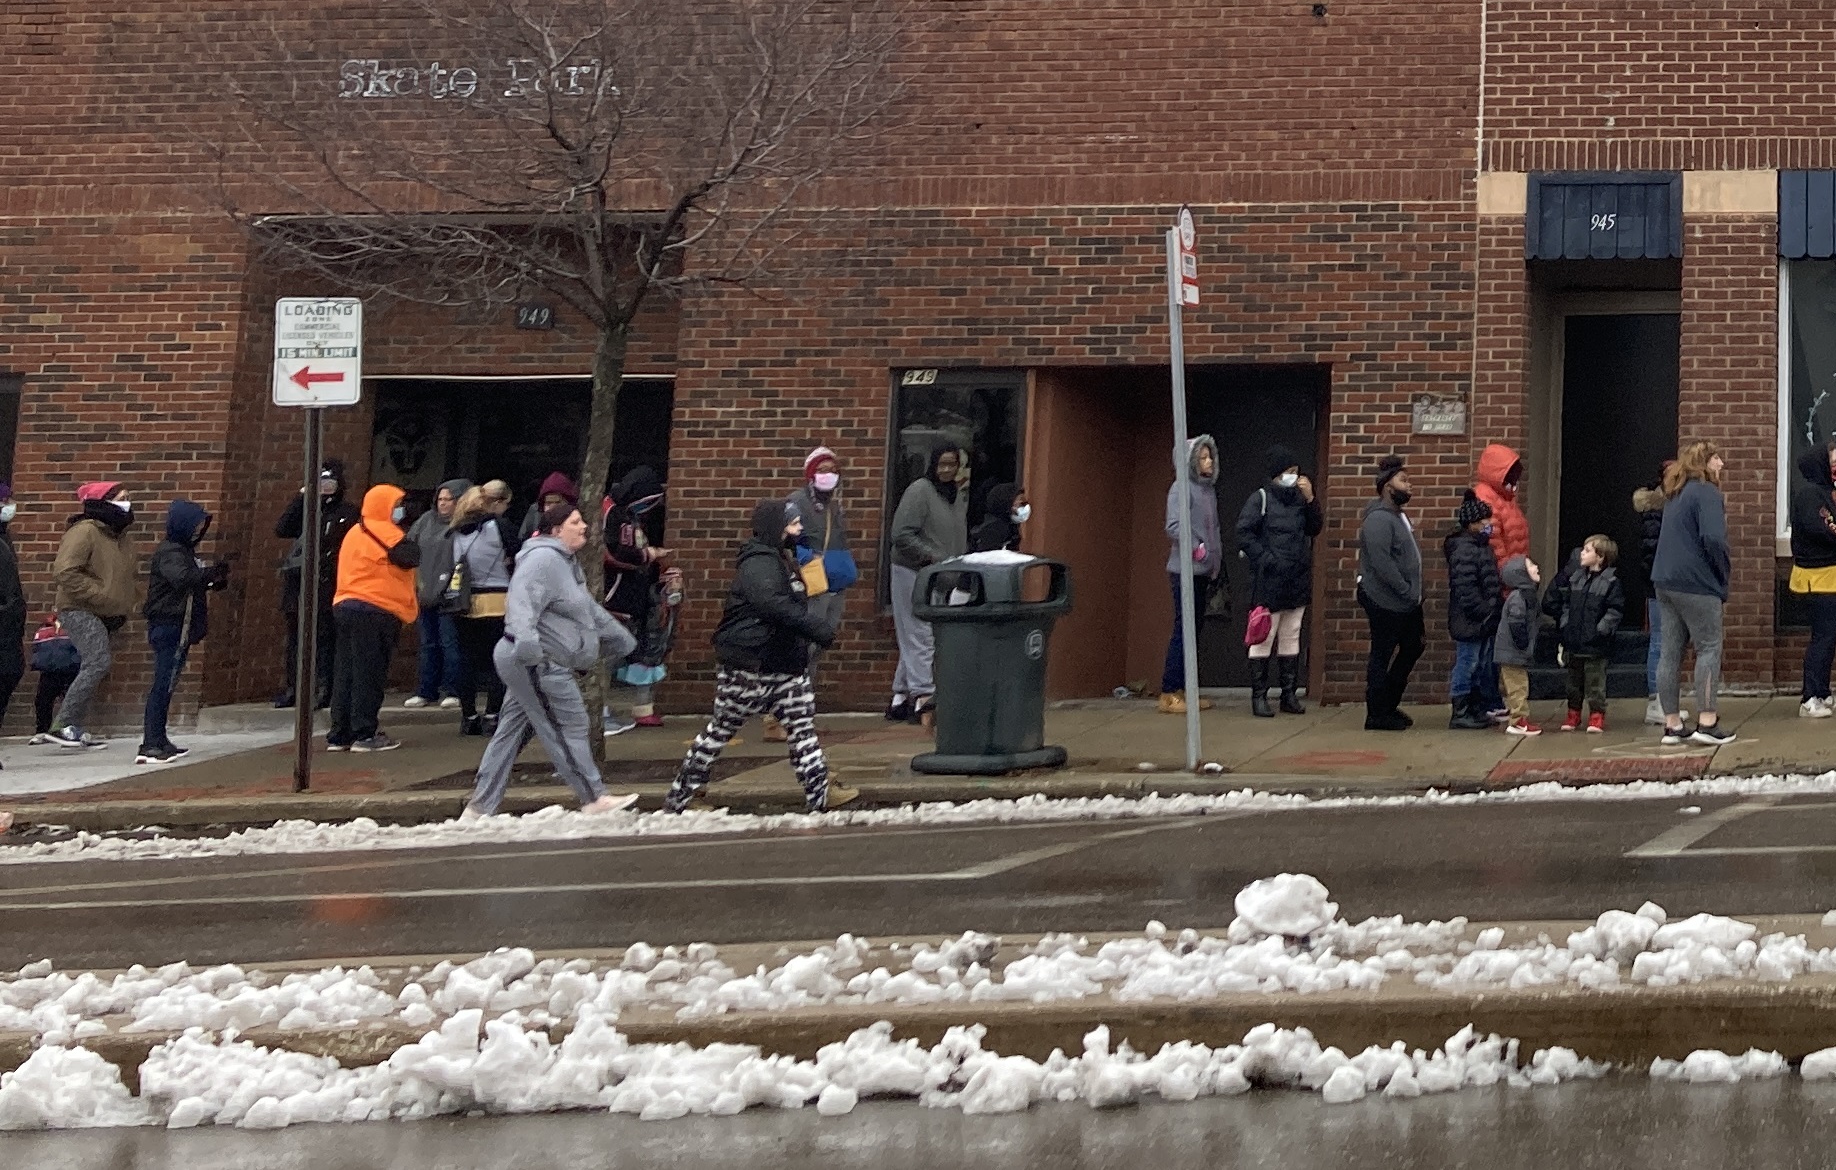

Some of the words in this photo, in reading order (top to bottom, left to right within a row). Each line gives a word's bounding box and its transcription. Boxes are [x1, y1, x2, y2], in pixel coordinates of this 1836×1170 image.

[338, 59, 478, 99] Skate
[1590, 214, 1617, 231] 945
[284, 304, 353, 316] LOADING
[519, 307, 550, 325] 949
[281, 348, 297, 358] 15
[323, 347, 353, 357] LIMIT
